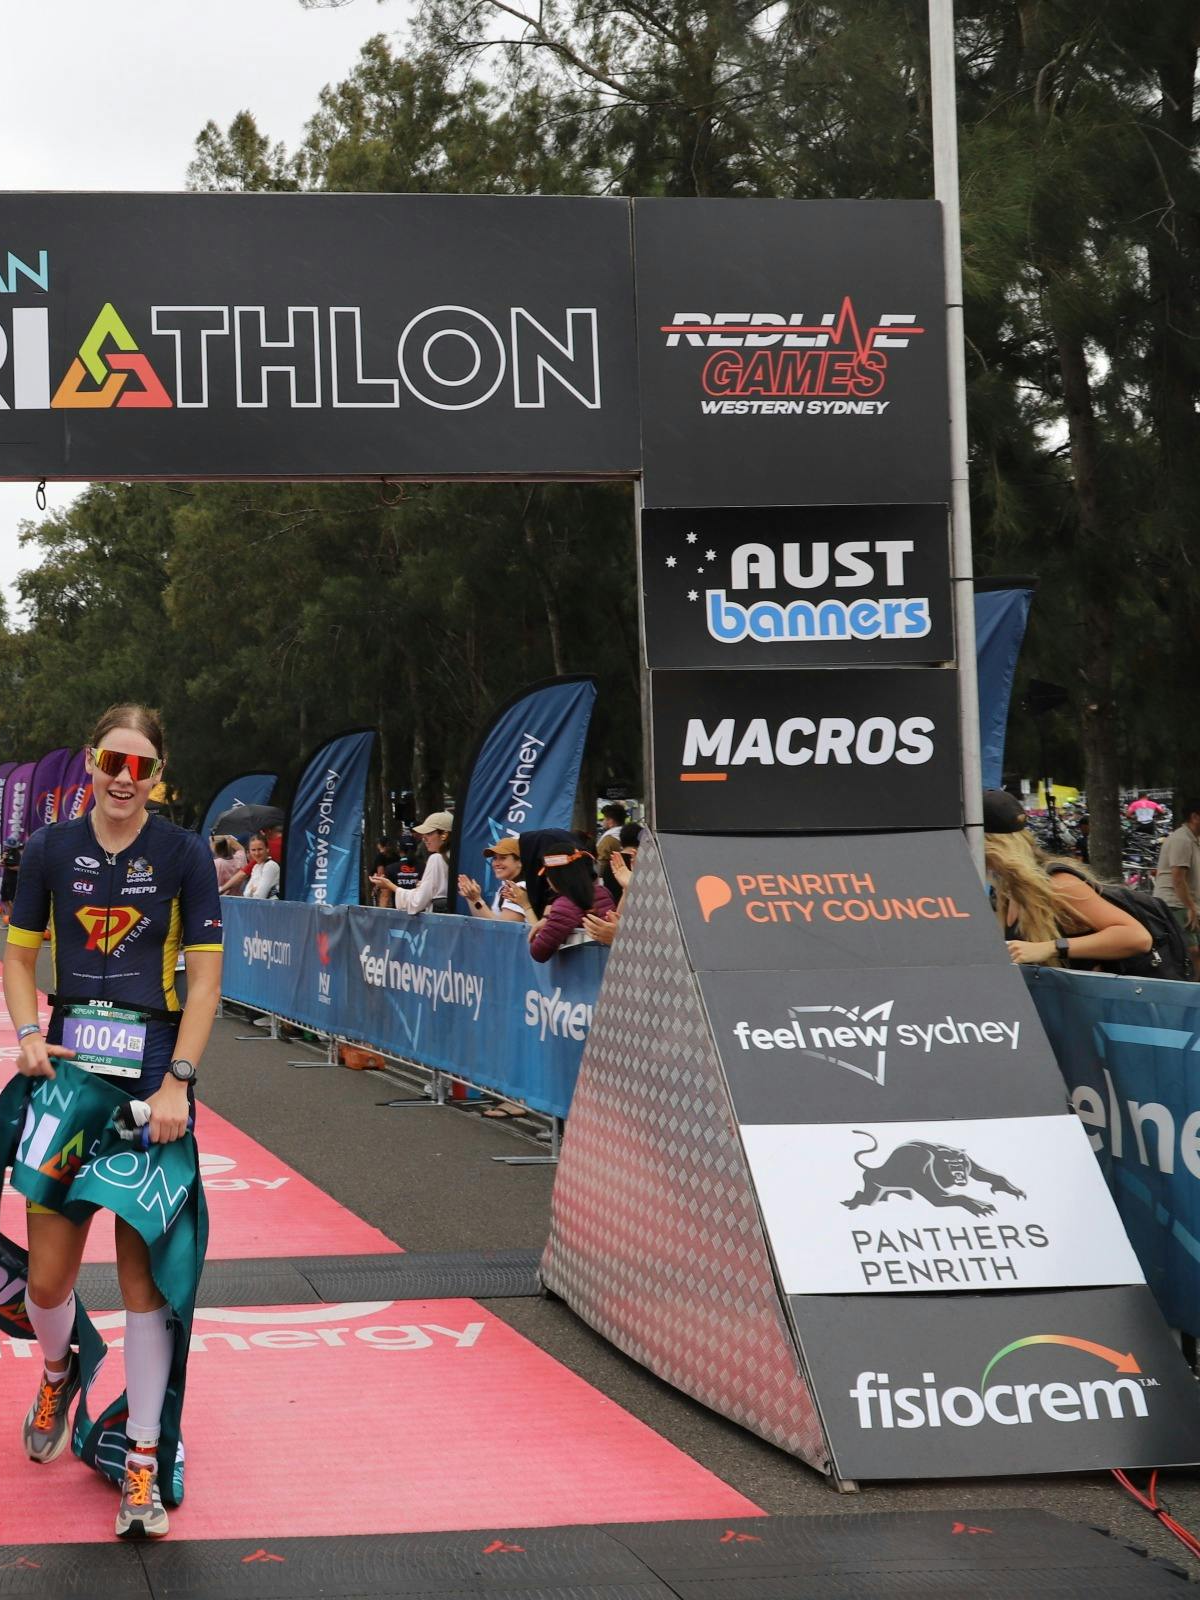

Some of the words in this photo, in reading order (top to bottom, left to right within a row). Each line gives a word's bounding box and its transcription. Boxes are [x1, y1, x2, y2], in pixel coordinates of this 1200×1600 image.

[702, 349, 888, 397] GAMES
[700, 400, 804, 415] WESTERN
[806, 401, 890, 415] SYDNEY
[731, 540, 914, 590] AUST
[705, 589, 932, 644] banners
[681, 716, 936, 766] MACROS
[508, 732, 545, 824] sydney
[318, 769, 340, 835] sydney
[314, 837, 330, 880] new
[73, 881, 94, 892] GU
[736, 872, 875, 896] PENRITH
[745, 900, 820, 923] CITY
[822, 896, 971, 923] COUNCIL
[113, 943, 126, 958] PP
[125, 916, 152, 943] TEAM
[243, 930, 291, 970] sydney.com
[88, 999, 113, 1008] 2XU
[359, 944, 390, 988] feel
[389, 960, 426, 996] new
[425, 959, 484, 1022] sydney
[74, 1023, 127, 1053] 1004
[733, 1016, 806, 1050] feel
[810, 1023, 888, 1048] new
[896, 1015, 1020, 1053] sydney
[851, 1223, 1050, 1254] PANTHERS
[861, 1256, 1019, 1286] PENRITH
[849, 1371, 1149, 1429] fisiocrem
